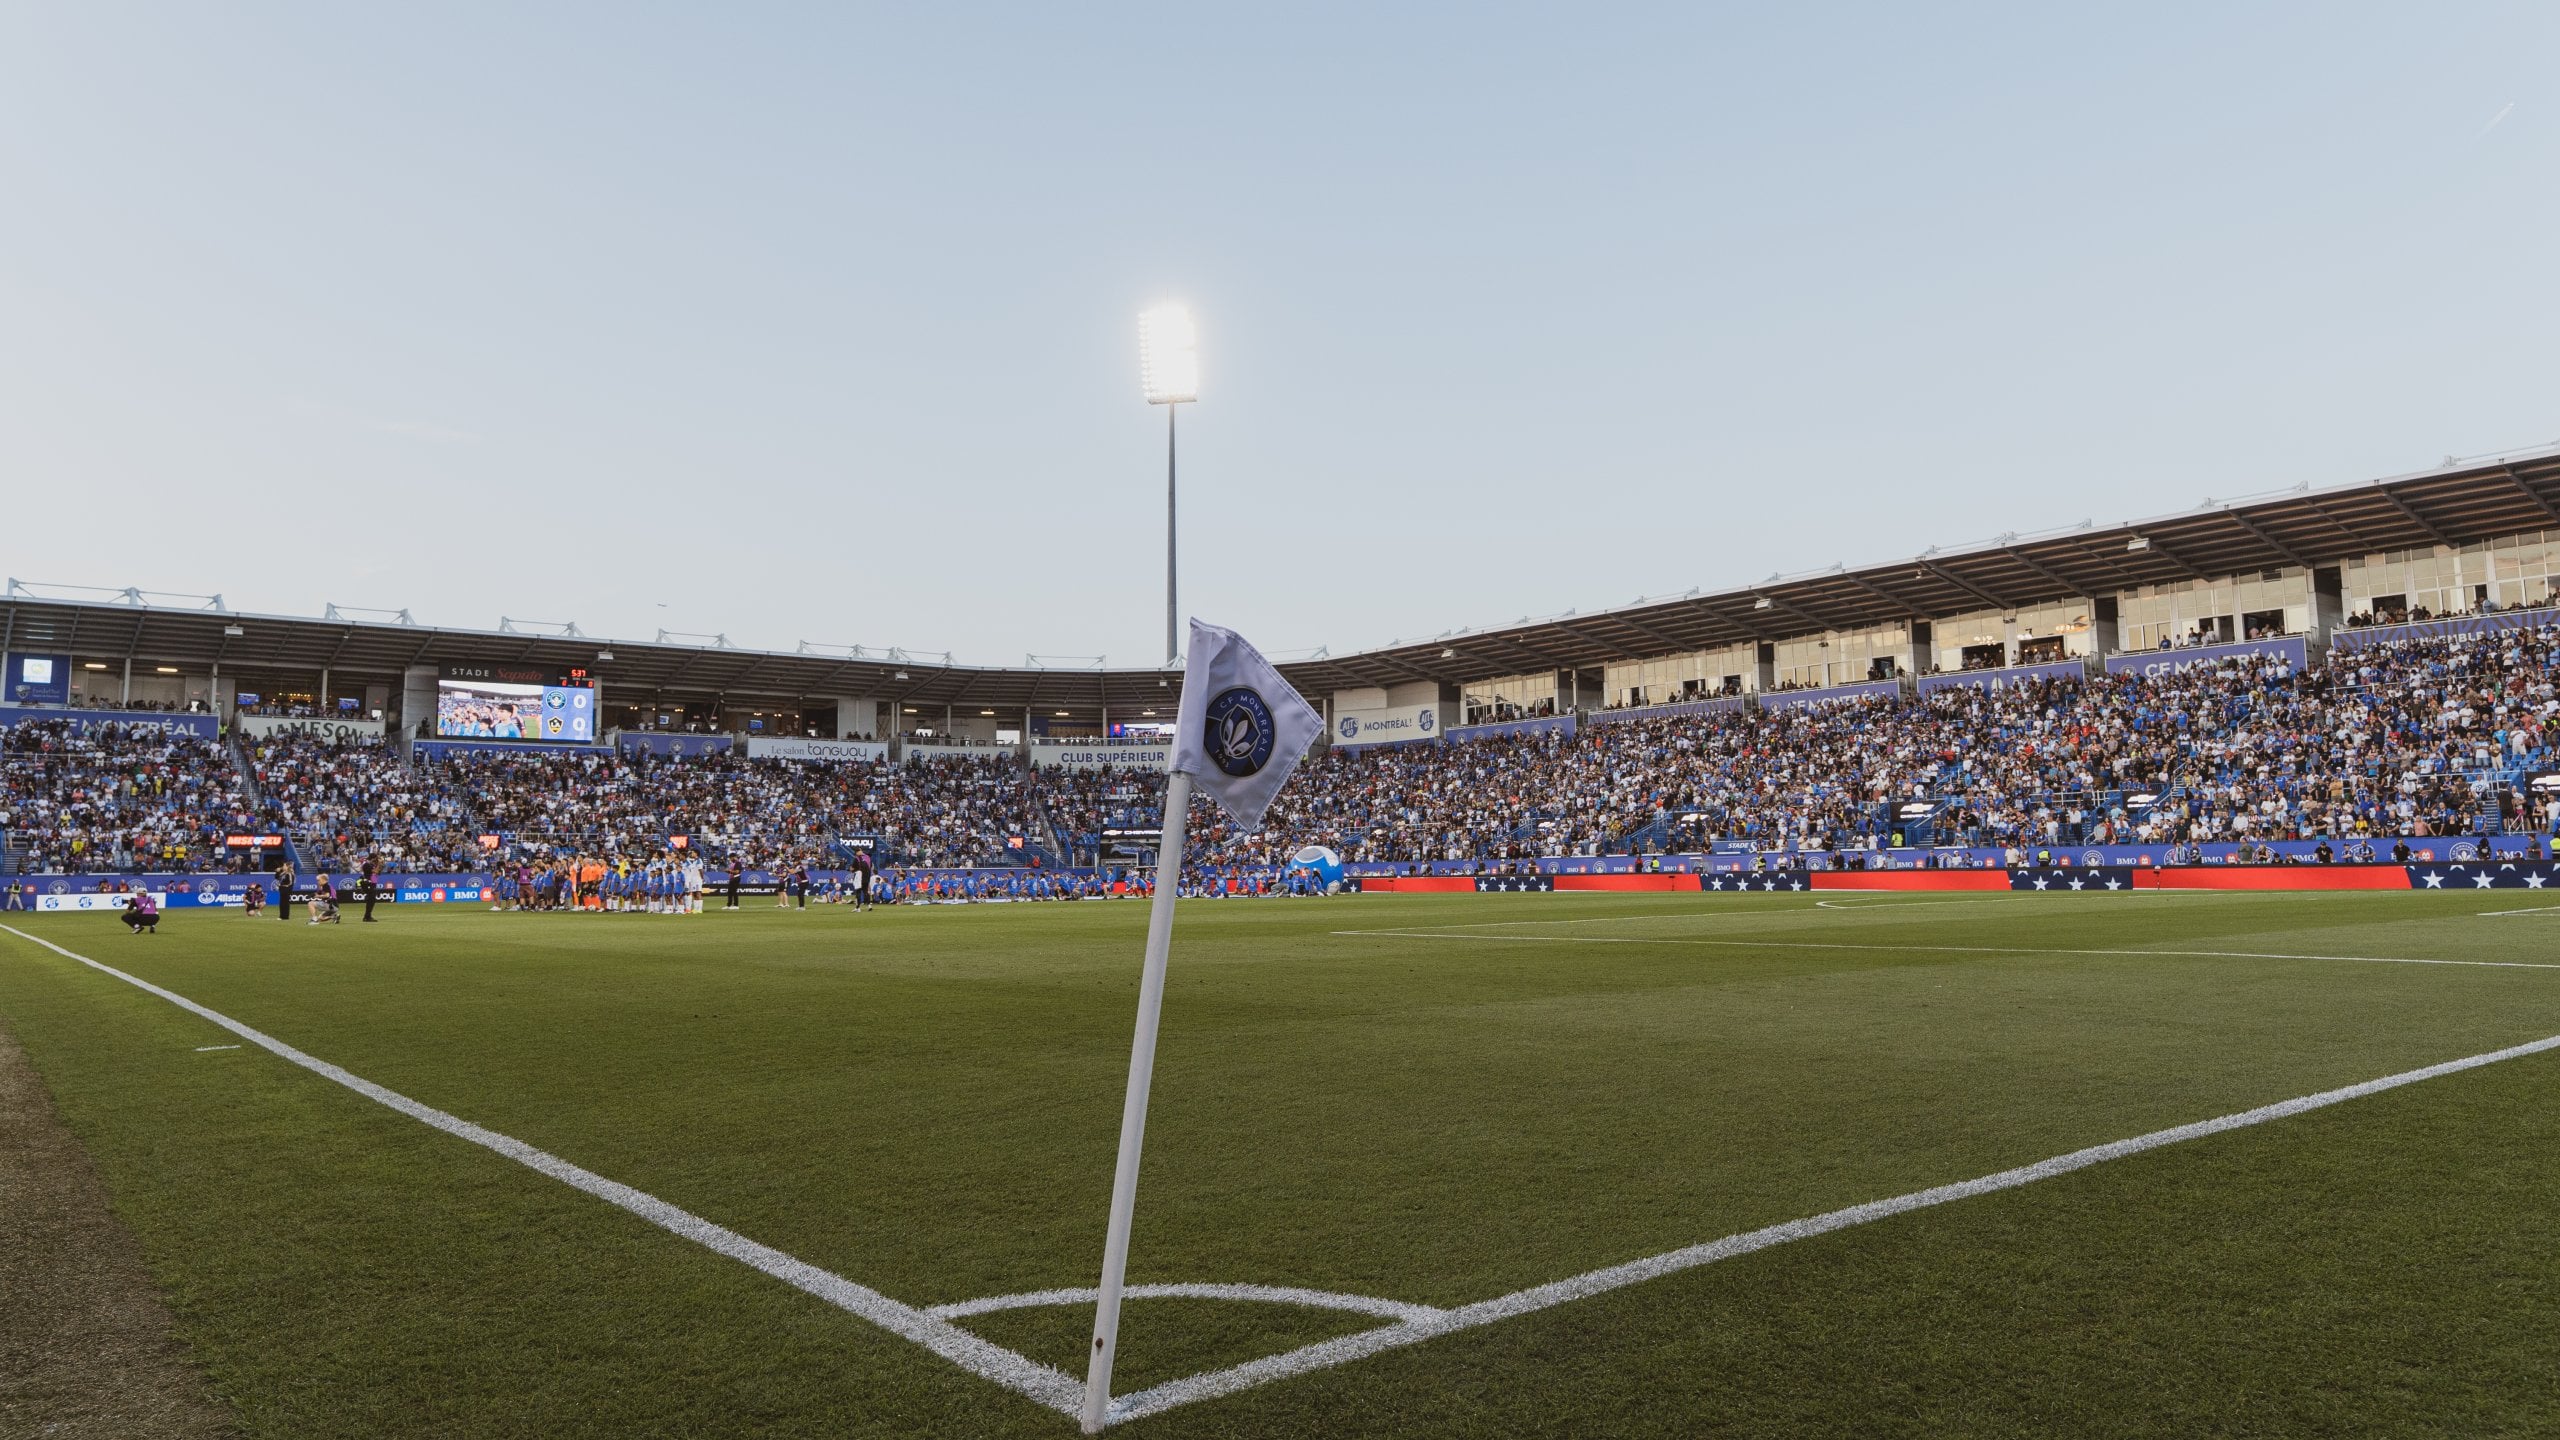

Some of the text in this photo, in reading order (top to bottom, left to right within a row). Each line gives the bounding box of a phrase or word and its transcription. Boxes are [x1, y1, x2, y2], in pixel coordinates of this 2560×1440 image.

[451, 667, 544, 681] STADE Saputo
[573, 694, 587, 709] 0
[572, 717, 586, 731] 0
[1220, 695, 1269, 752] CF MONTRÉAL
[266, 721, 363, 745] JAMESON
[771, 742, 867, 761] Le salon tanguay
[1061, 749, 1165, 763] CLUB SUPÉRIEUR
[404, 892, 429, 900] BMO
[454, 890, 478, 899] BMO
